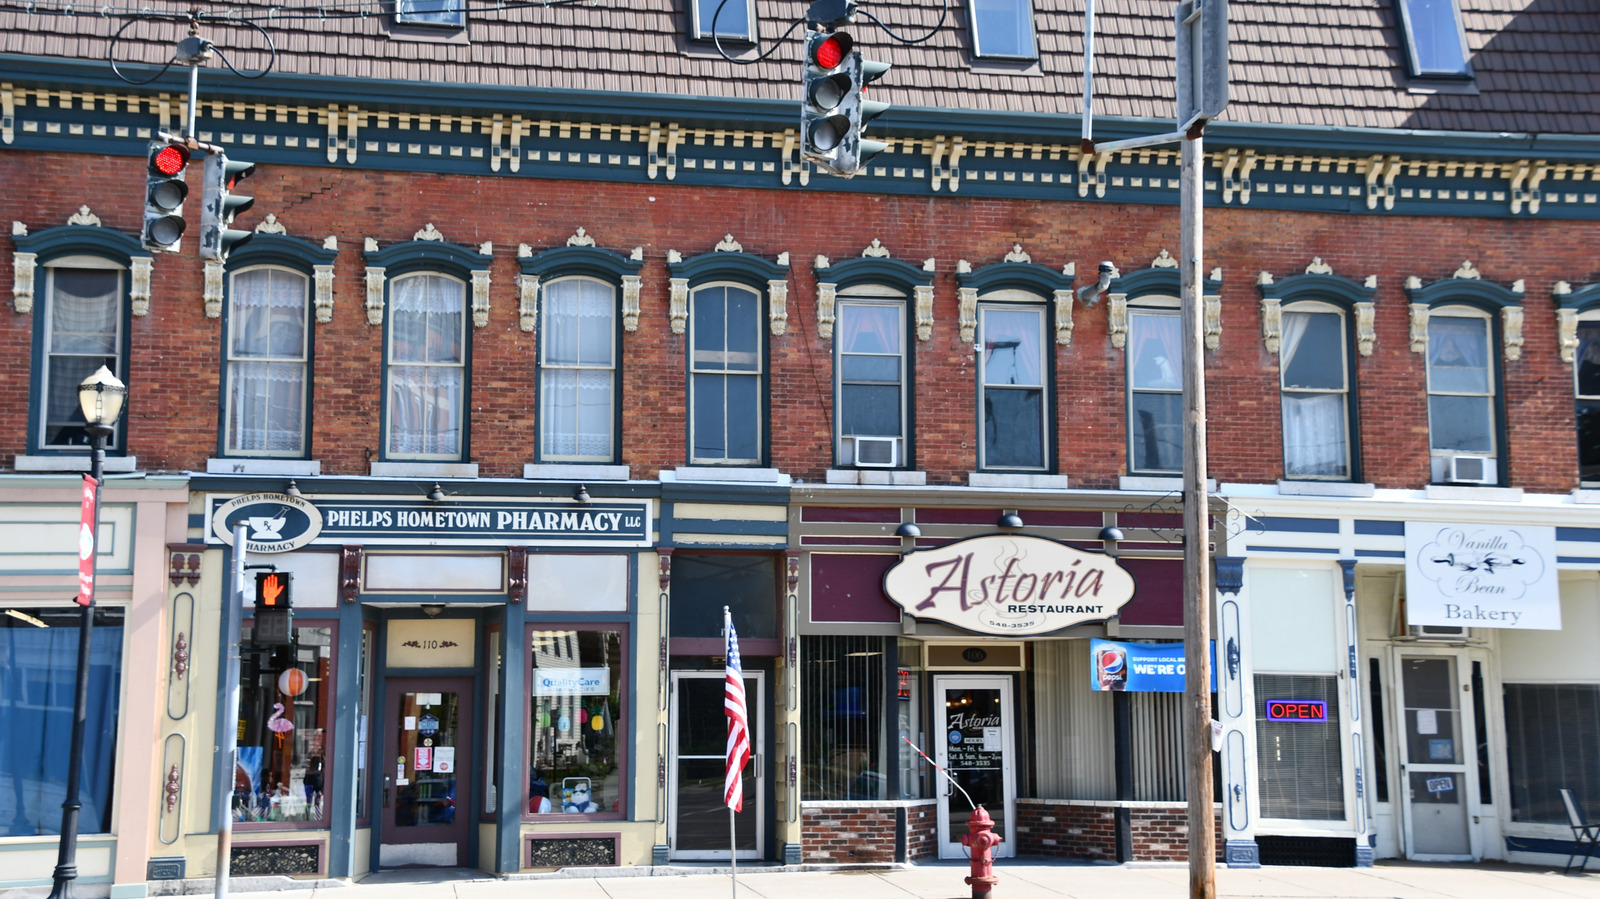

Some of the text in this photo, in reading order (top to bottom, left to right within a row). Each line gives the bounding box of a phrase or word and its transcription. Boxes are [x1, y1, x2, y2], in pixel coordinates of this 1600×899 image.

[231, 493, 307, 508] PHELPS HOMETOWN
[327, 510, 641, 531] PHELPS HOMETOWN PHARMACY LLC
[246, 541, 295, 552] HARMACY
[1447, 530, 1508, 550] Vanilla
[914, 552, 1104, 612] Astoria
[1455, 574, 1506, 594] Bean
[1007, 604, 1104, 614] RESTAURANT
[1444, 603, 1522, 626] Bakery
[989, 620, 1035, 629] 548-3535
[422, 640, 438, 650] 110
[1133, 664, 1175, 675] WE'RE
[1270, 703, 1323, 719] OPEN
[947, 712, 1000, 730] Astoria
